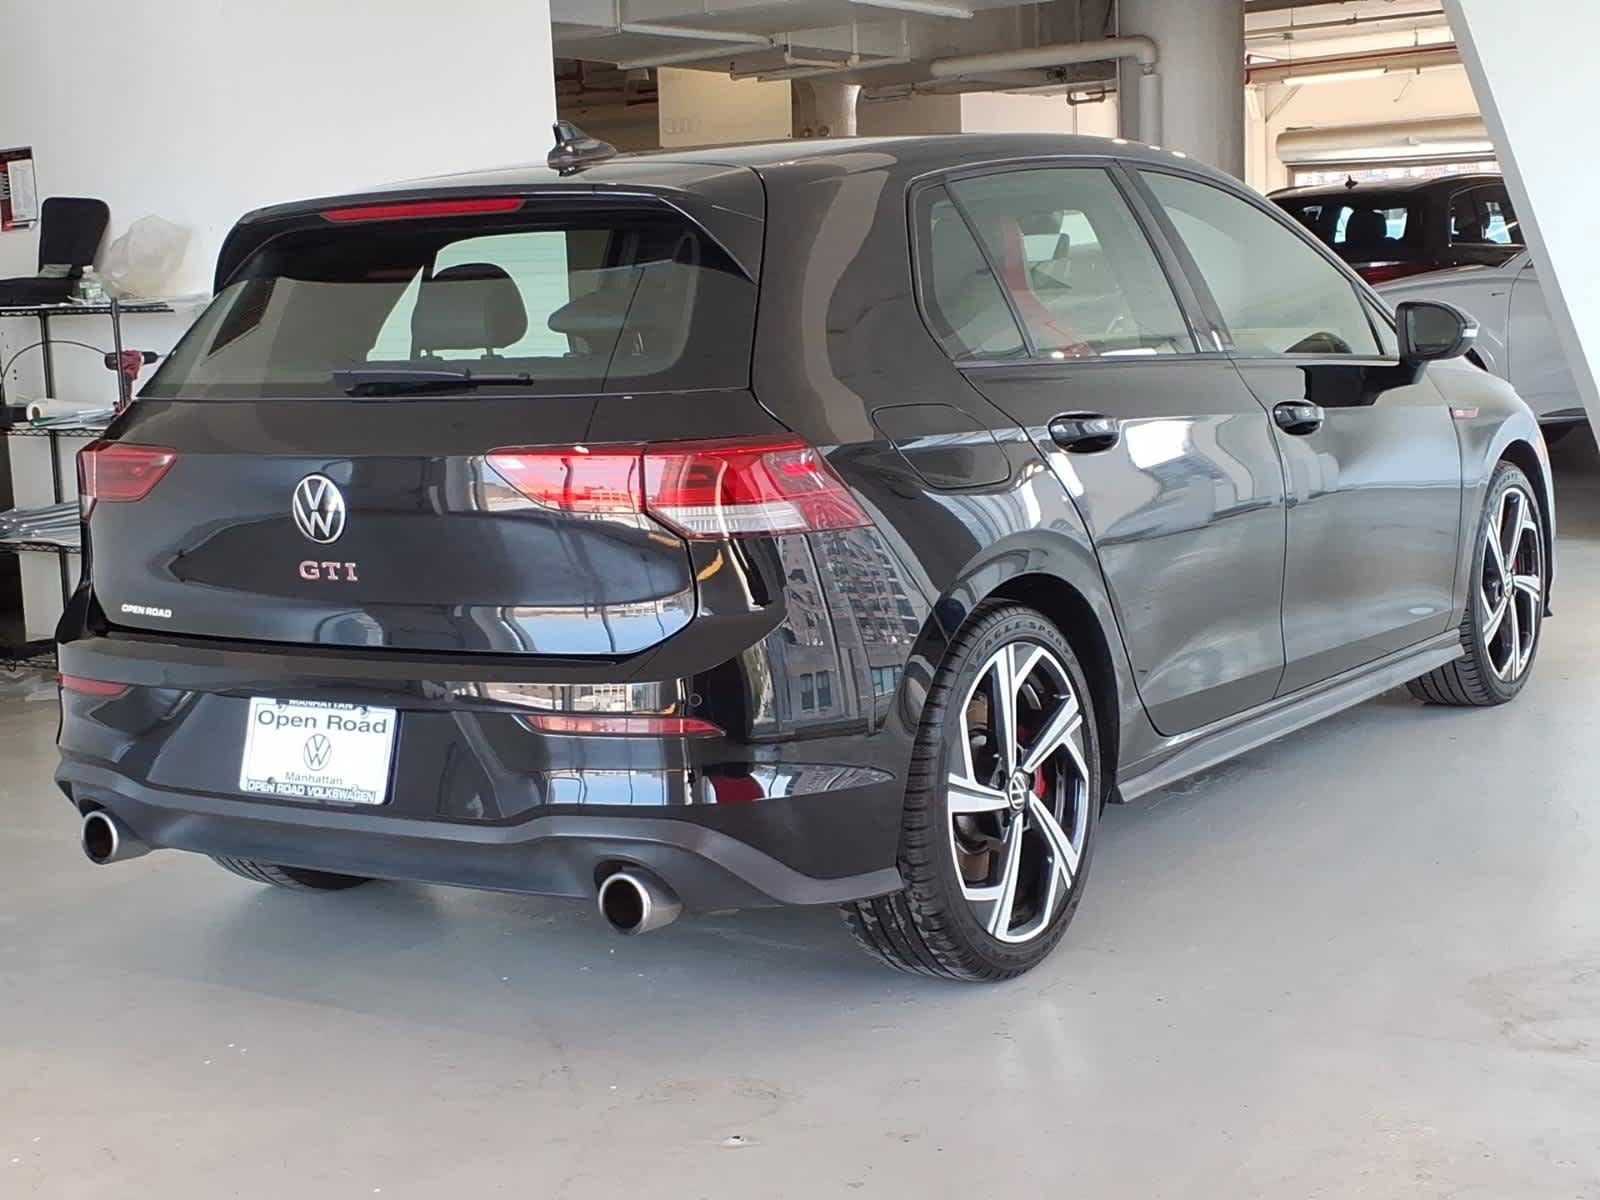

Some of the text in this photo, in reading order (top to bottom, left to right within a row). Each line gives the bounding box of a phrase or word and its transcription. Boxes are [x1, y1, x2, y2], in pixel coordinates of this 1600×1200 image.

[299, 560, 358, 581] GTI
[121, 604, 172, 618] OPEN ROAD
[258, 710, 387, 734] Open Road
[285, 771, 343, 785] Manhattan
[247, 780, 377, 802] OPEN ROAD VOLKSWAGEN
